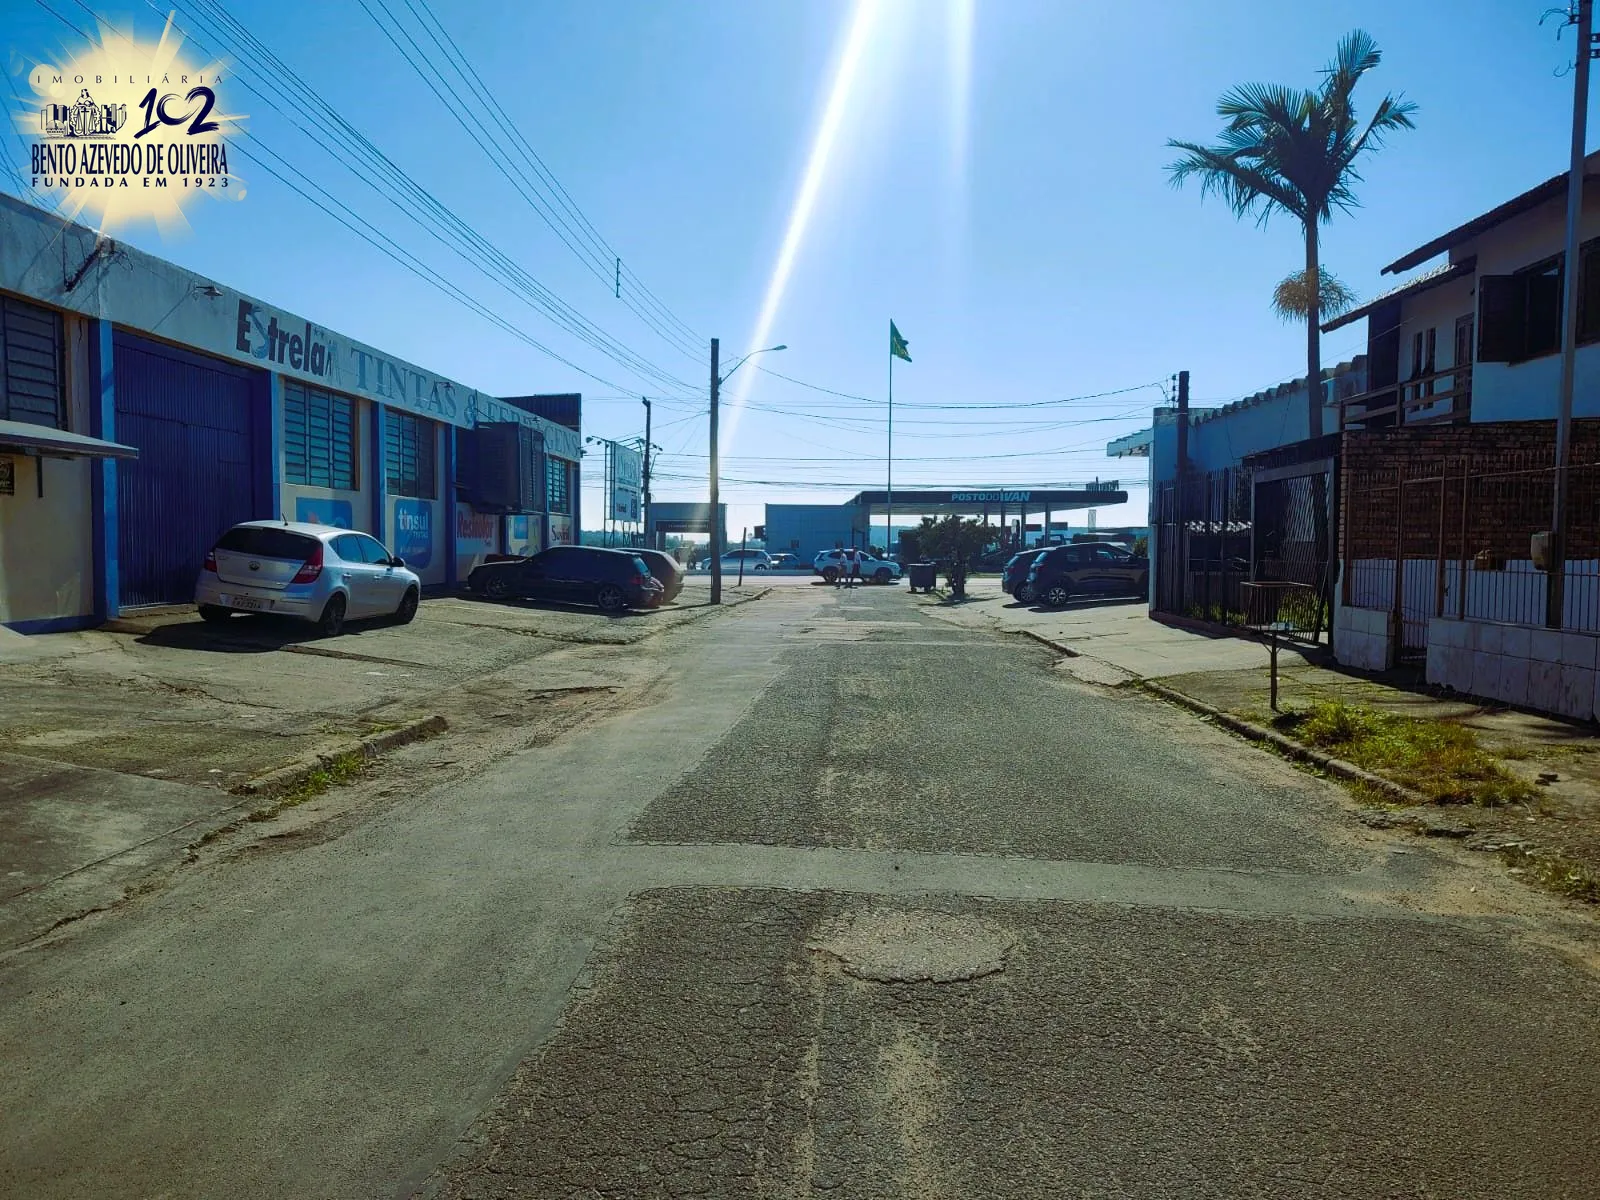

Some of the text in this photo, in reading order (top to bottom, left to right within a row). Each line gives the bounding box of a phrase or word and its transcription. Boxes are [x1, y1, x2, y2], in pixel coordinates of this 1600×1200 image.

[236, 298, 326, 377] Estrela
[350, 349, 458, 419] TINTAS
[398, 507, 429, 530] tinsul
[951, 493, 985, 502] POSTO
